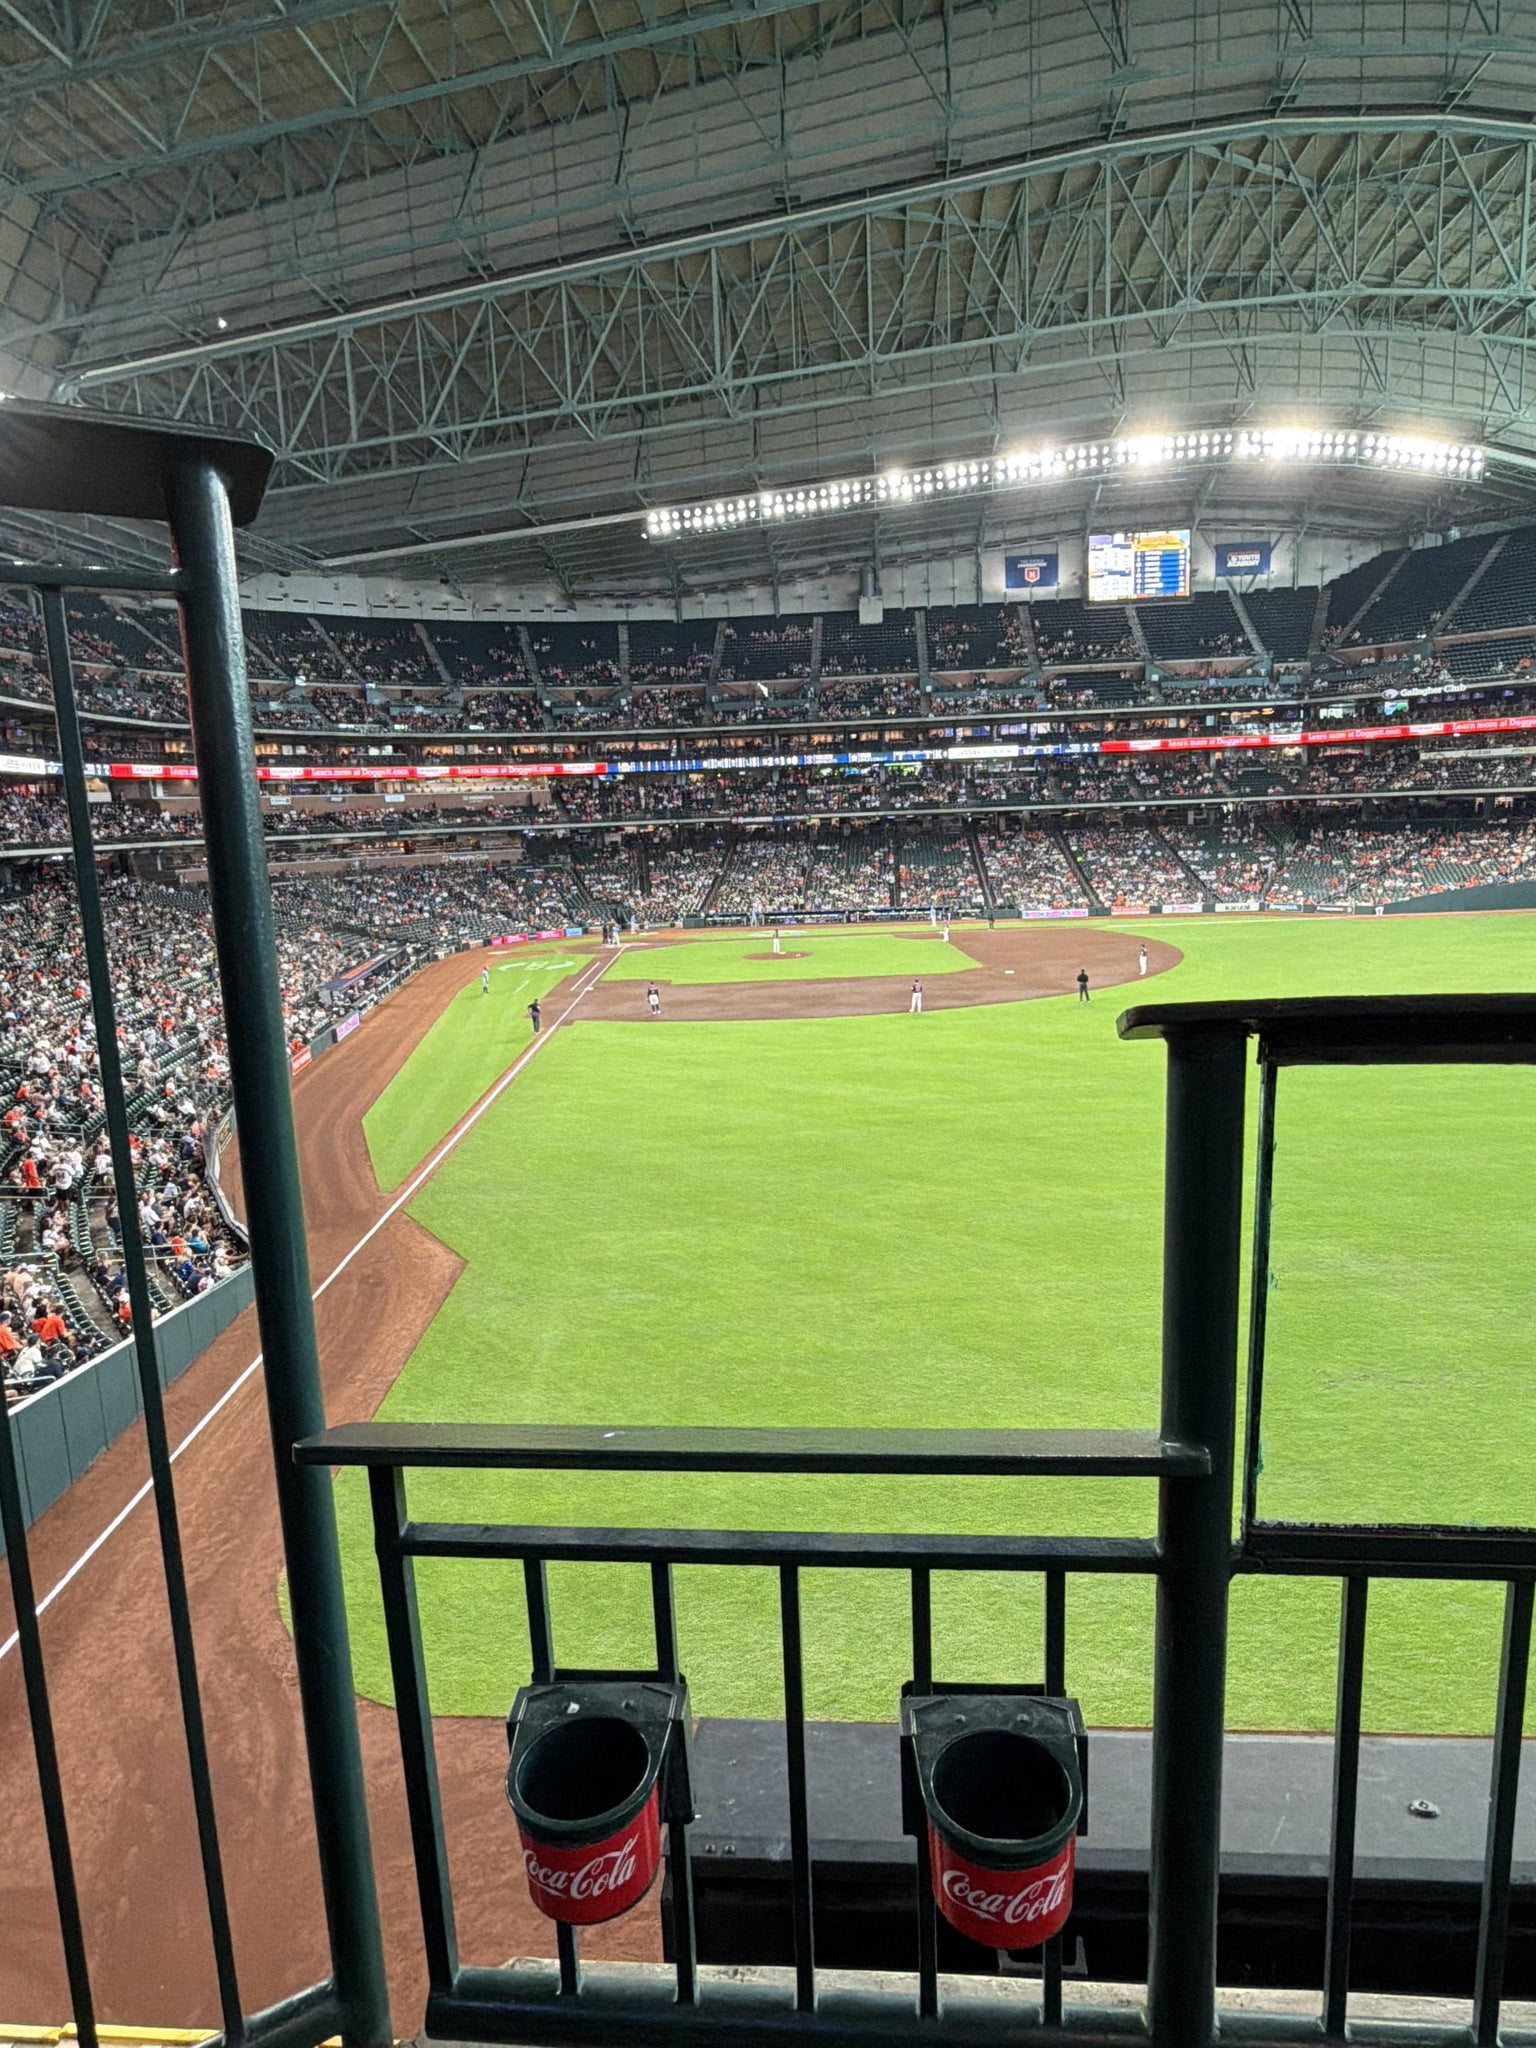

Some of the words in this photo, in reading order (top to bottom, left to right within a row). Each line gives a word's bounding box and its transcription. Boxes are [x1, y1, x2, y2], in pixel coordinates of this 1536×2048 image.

[1400, 686, 1443, 697] Gallagher
[1443, 683, 1467, 693] Club
[522, 1833, 639, 1900] Coca-Cola
[943, 1859, 1070, 1924] Coca-Cola
